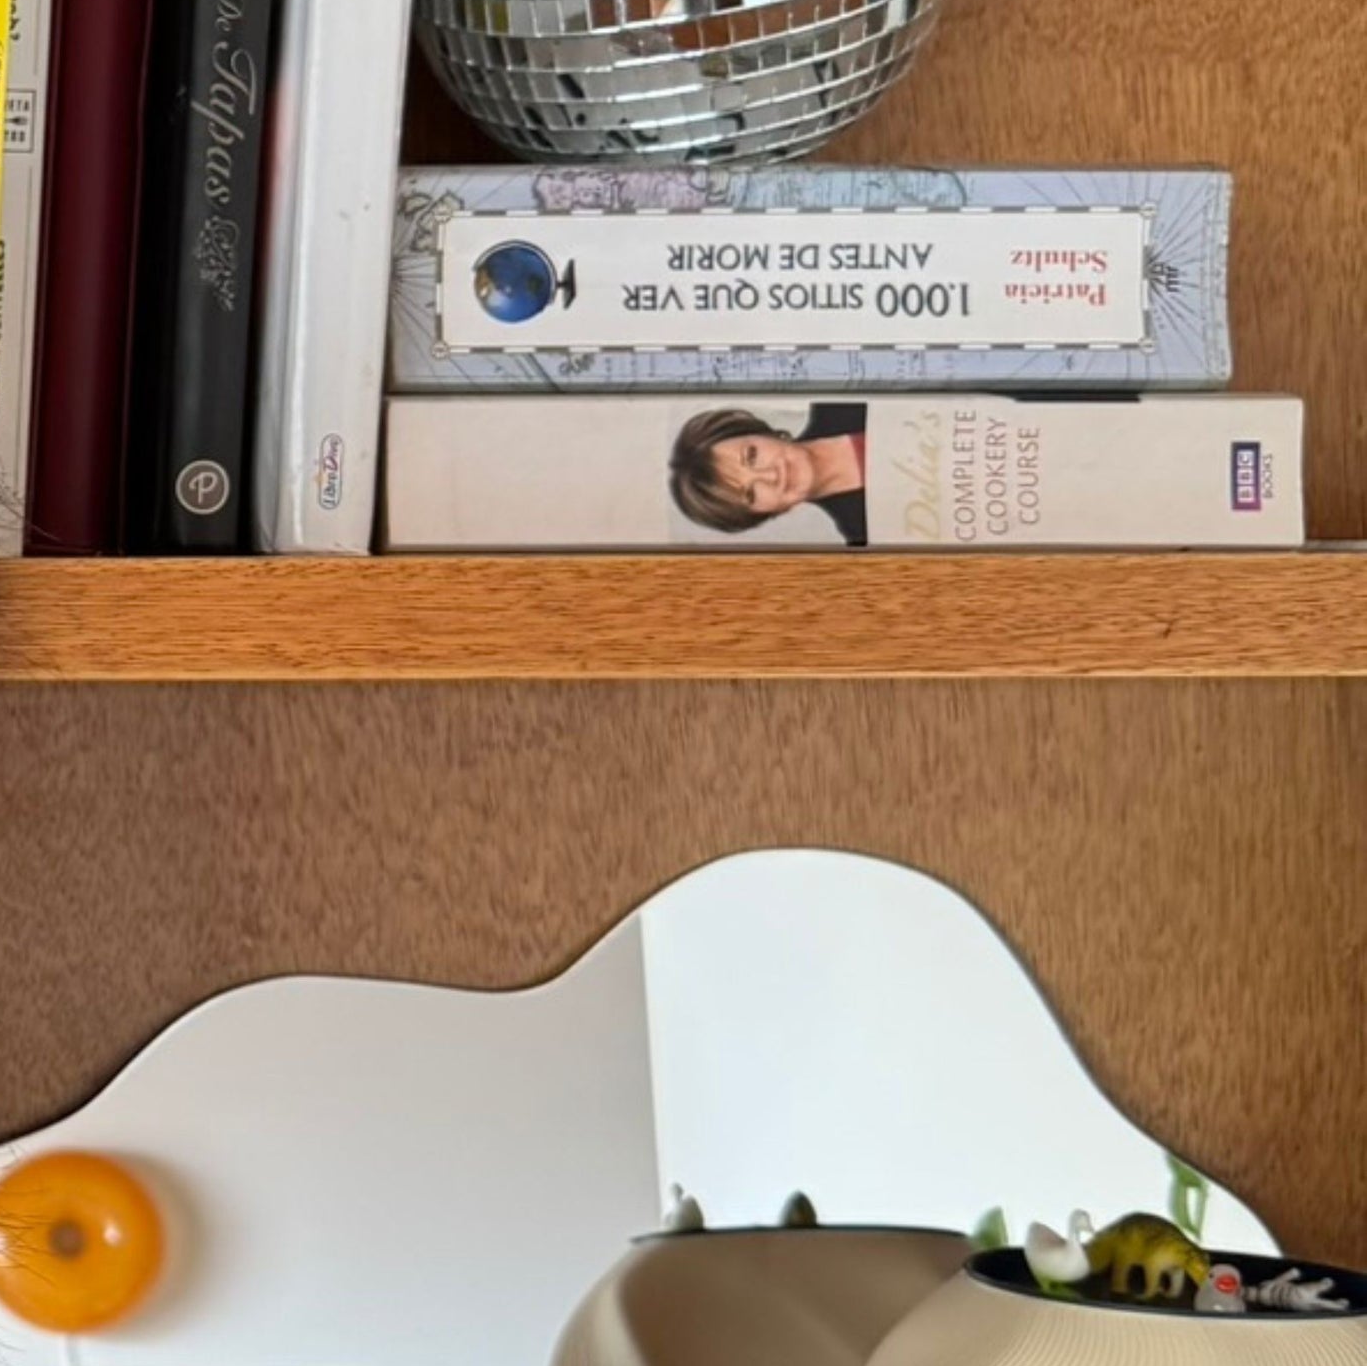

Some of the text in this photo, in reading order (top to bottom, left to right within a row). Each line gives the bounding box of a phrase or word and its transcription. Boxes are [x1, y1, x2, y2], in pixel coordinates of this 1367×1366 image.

[192, 47, 258, 208] Tapas
[668, 243, 932, 271] ANTES DE MORIR
[1011, 249, 1107, 273] Schultz
[623, 279, 971, 317] 1.000 SITIOS QUE VER
[1004, 282, 1107, 306] Patricia
[953, 408, 977, 543] COMPLETE
[985, 416, 1008, 536] COOKERY
[1018, 426, 1041, 526] COURSE
[1236, 449, 1256, 503] BBC
[1262, 454, 1274, 499] BOOKS
